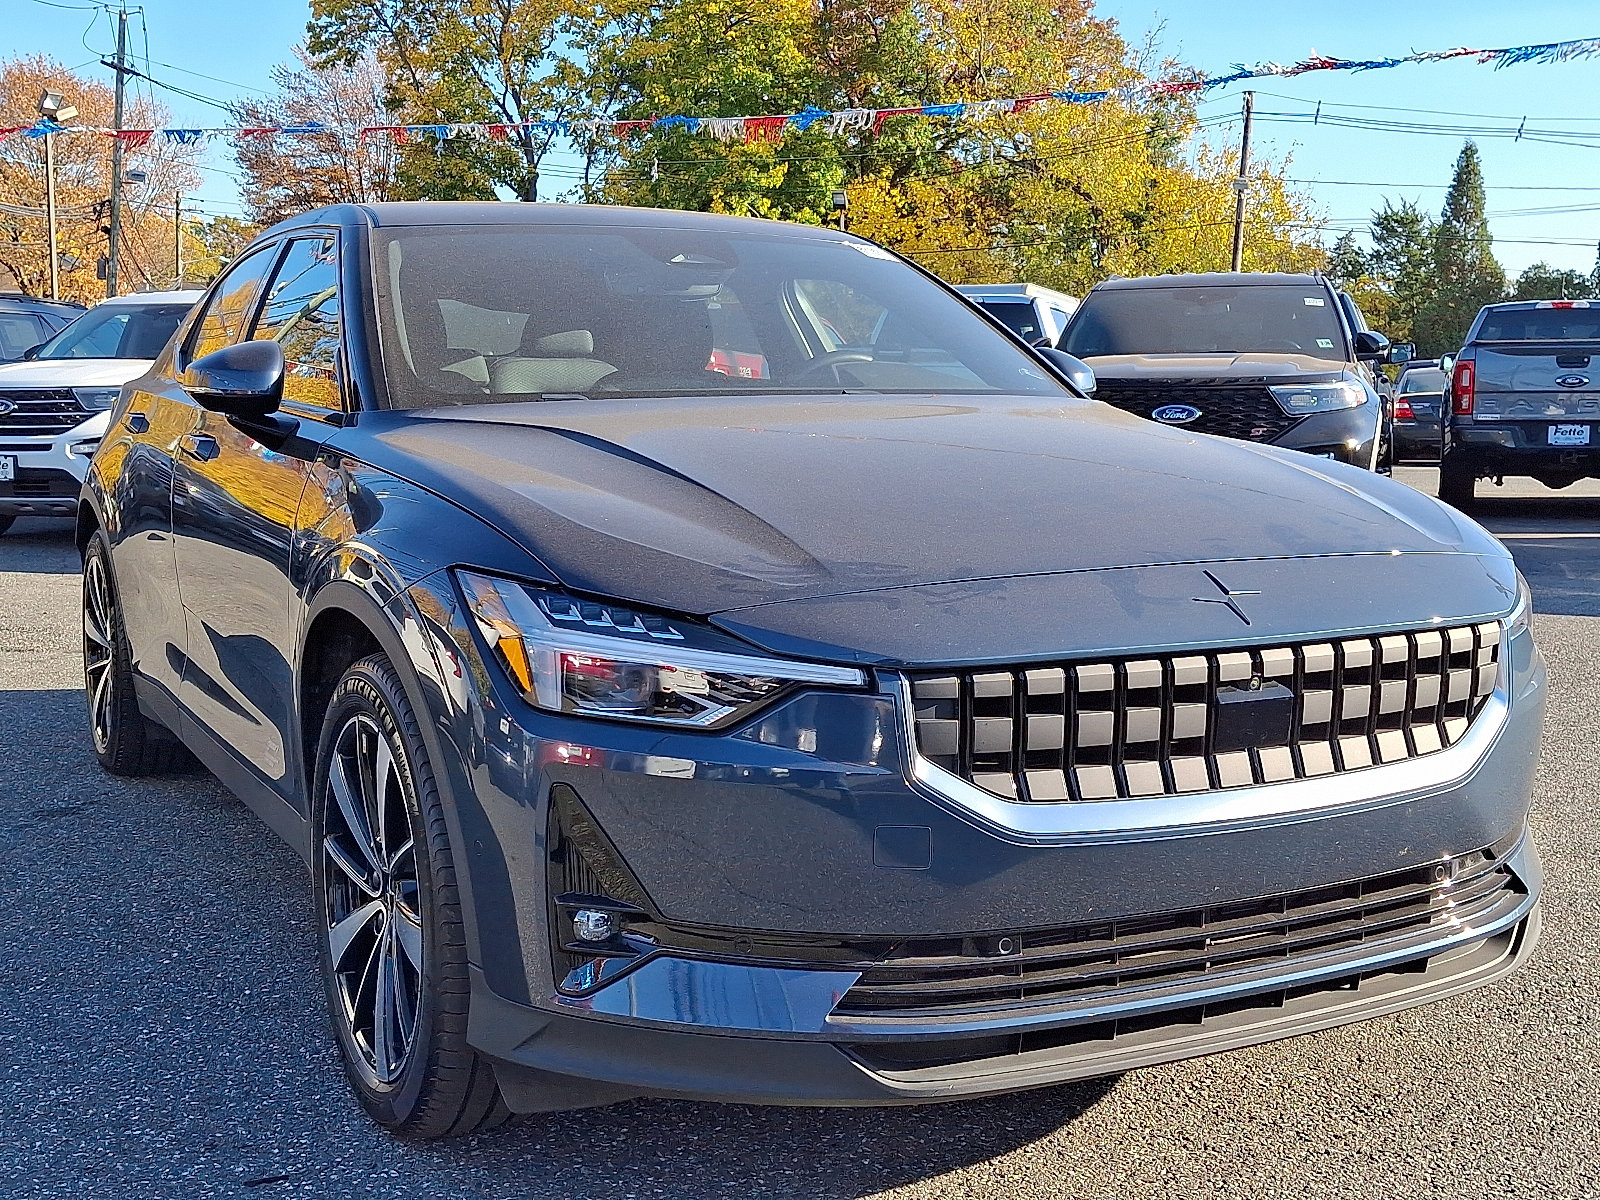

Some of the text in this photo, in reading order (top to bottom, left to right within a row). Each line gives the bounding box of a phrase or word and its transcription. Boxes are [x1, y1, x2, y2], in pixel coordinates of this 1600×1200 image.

[1162, 408, 1189, 420] Ford
[1553, 427, 1585, 436] Fette
[346, 678, 393, 732] MICHELIN
[396, 745, 415, 799] PRIMACY
